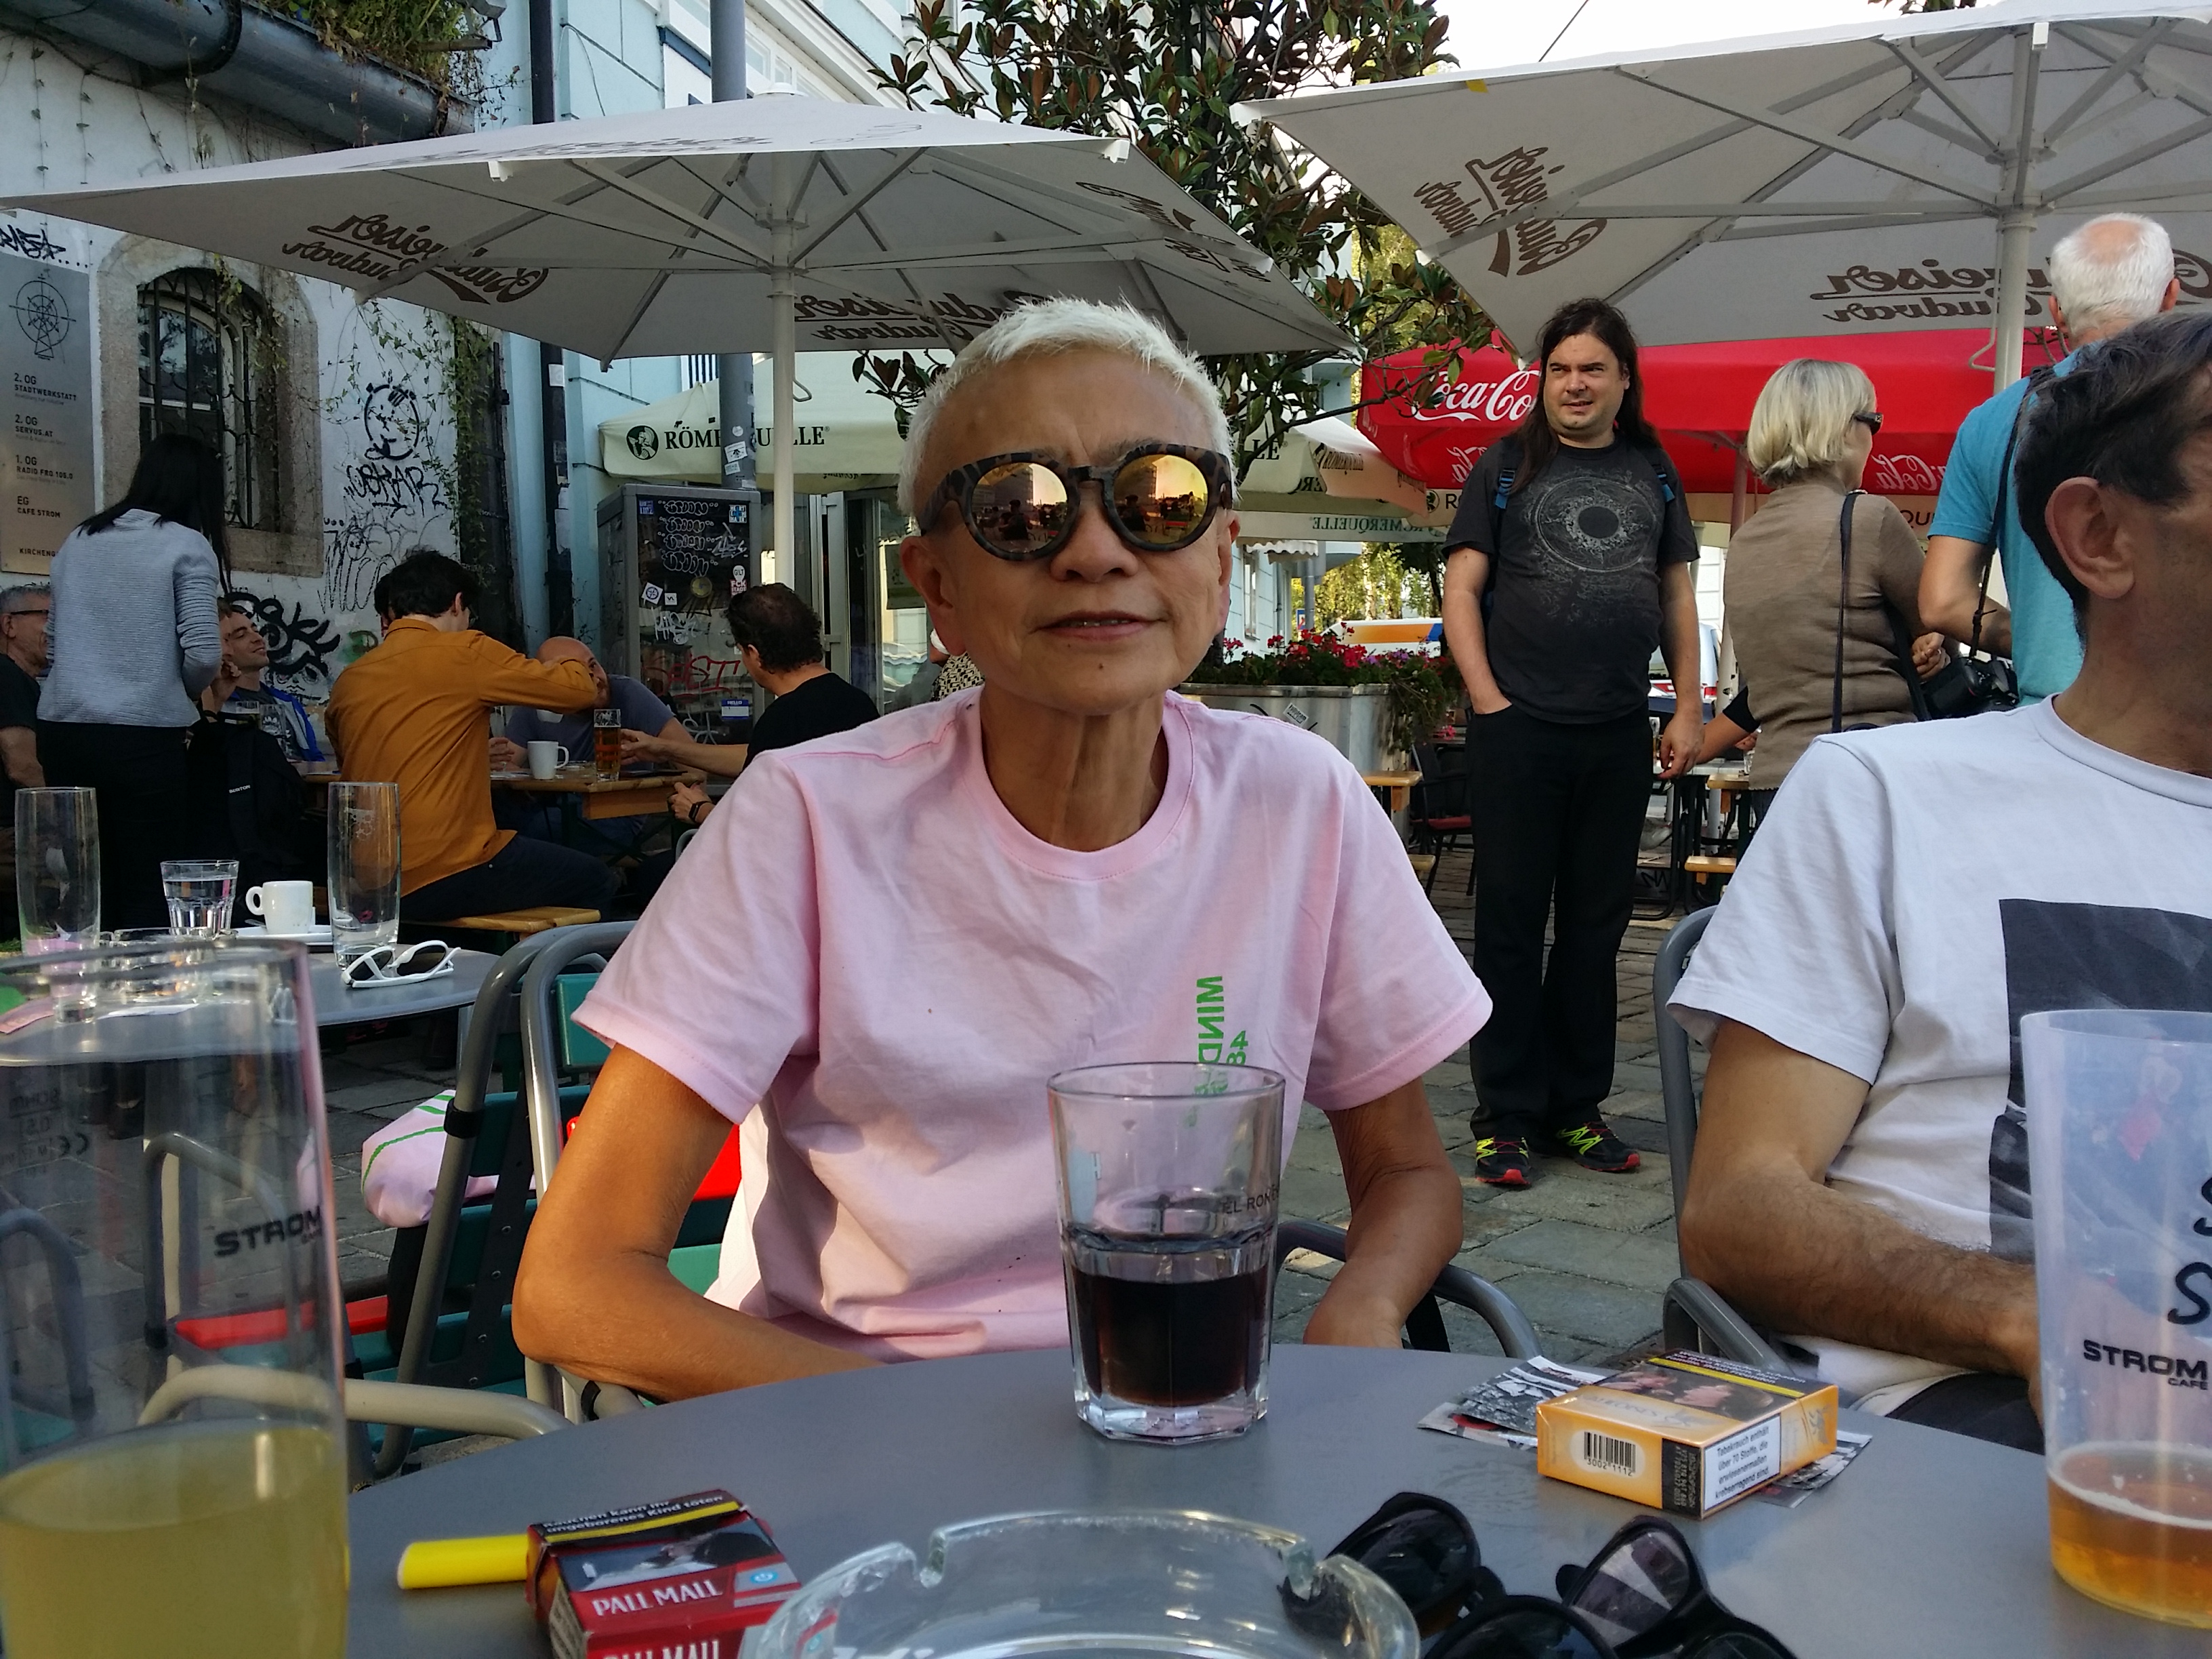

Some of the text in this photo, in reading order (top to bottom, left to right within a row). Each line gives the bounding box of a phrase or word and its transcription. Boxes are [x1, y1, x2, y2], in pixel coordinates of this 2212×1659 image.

[24, 375, 37, 385] OG
[14, 384, 77, 401] STADTWERKSTATT
[1412, 370, 1540, 422] oca-Co
[25, 415, 38, 426] OG
[15, 426, 53, 437] SERVUS.AT
[25, 455, 37, 466] OG
[16, 466, 38, 474] RADIO
[17, 495, 29, 505] EG
[17, 508, 35, 516] CAFE
[20, 548, 57, 557] KIRCHENG
[731, 579, 746, 588] FCK
[228, 784, 251, 794] BURTON
[214, 1206, 321, 1257] STROM
[2083, 1339, 2208, 1380] STROM
[2168, 1378, 2208, 1391] CAFE
[1587, 1458, 1633, 1477] 3002 1112
[610, 1504, 647, 1517] kann
[547, 1513, 644, 1533] ungeborenes
[647, 1502, 681, 1517] Kind
[592, 1579, 723, 1616] PALL MALL
